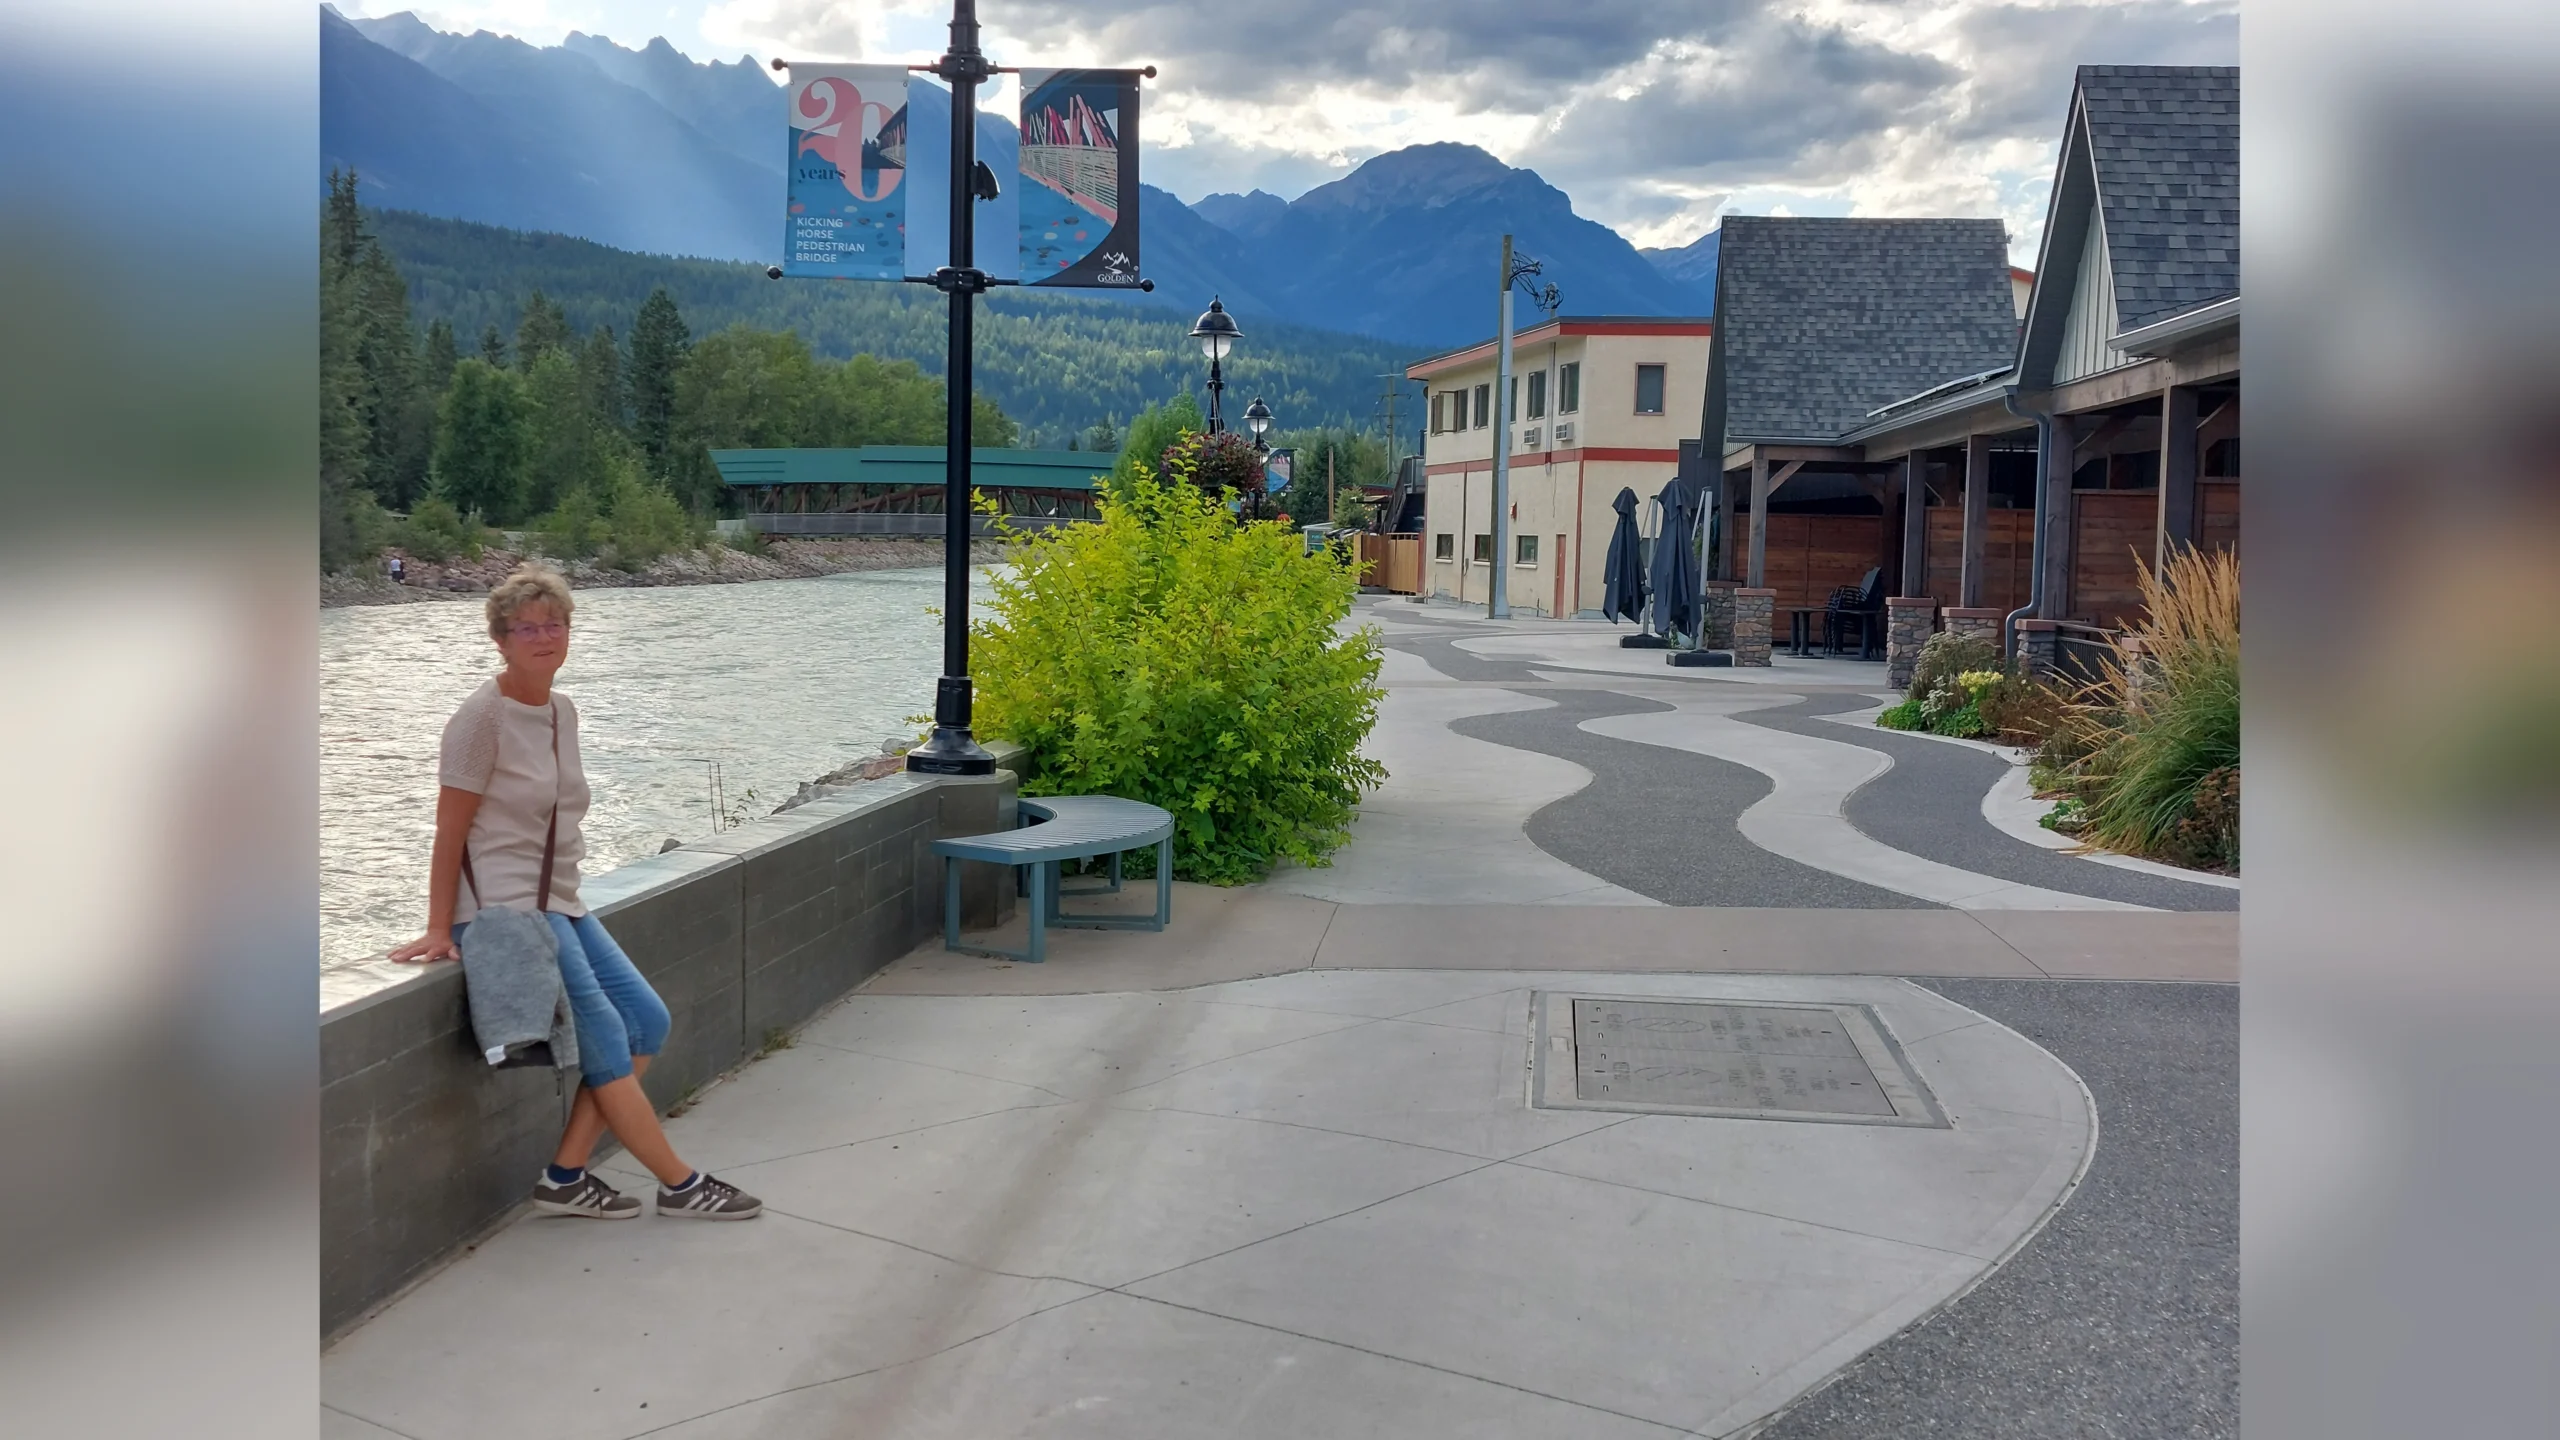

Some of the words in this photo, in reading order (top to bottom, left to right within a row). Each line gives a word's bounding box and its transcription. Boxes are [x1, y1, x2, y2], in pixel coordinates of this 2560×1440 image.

[798, 77, 905, 202] 20
[799, 168, 846, 183] years
[797, 217, 844, 228] KICKING
[796, 229, 834, 239] HORSE
[796, 241, 865, 252] PEDESTRIAN
[795, 252, 837, 263] BRIDGE
[1097, 273, 1134, 283] GOLDEN
